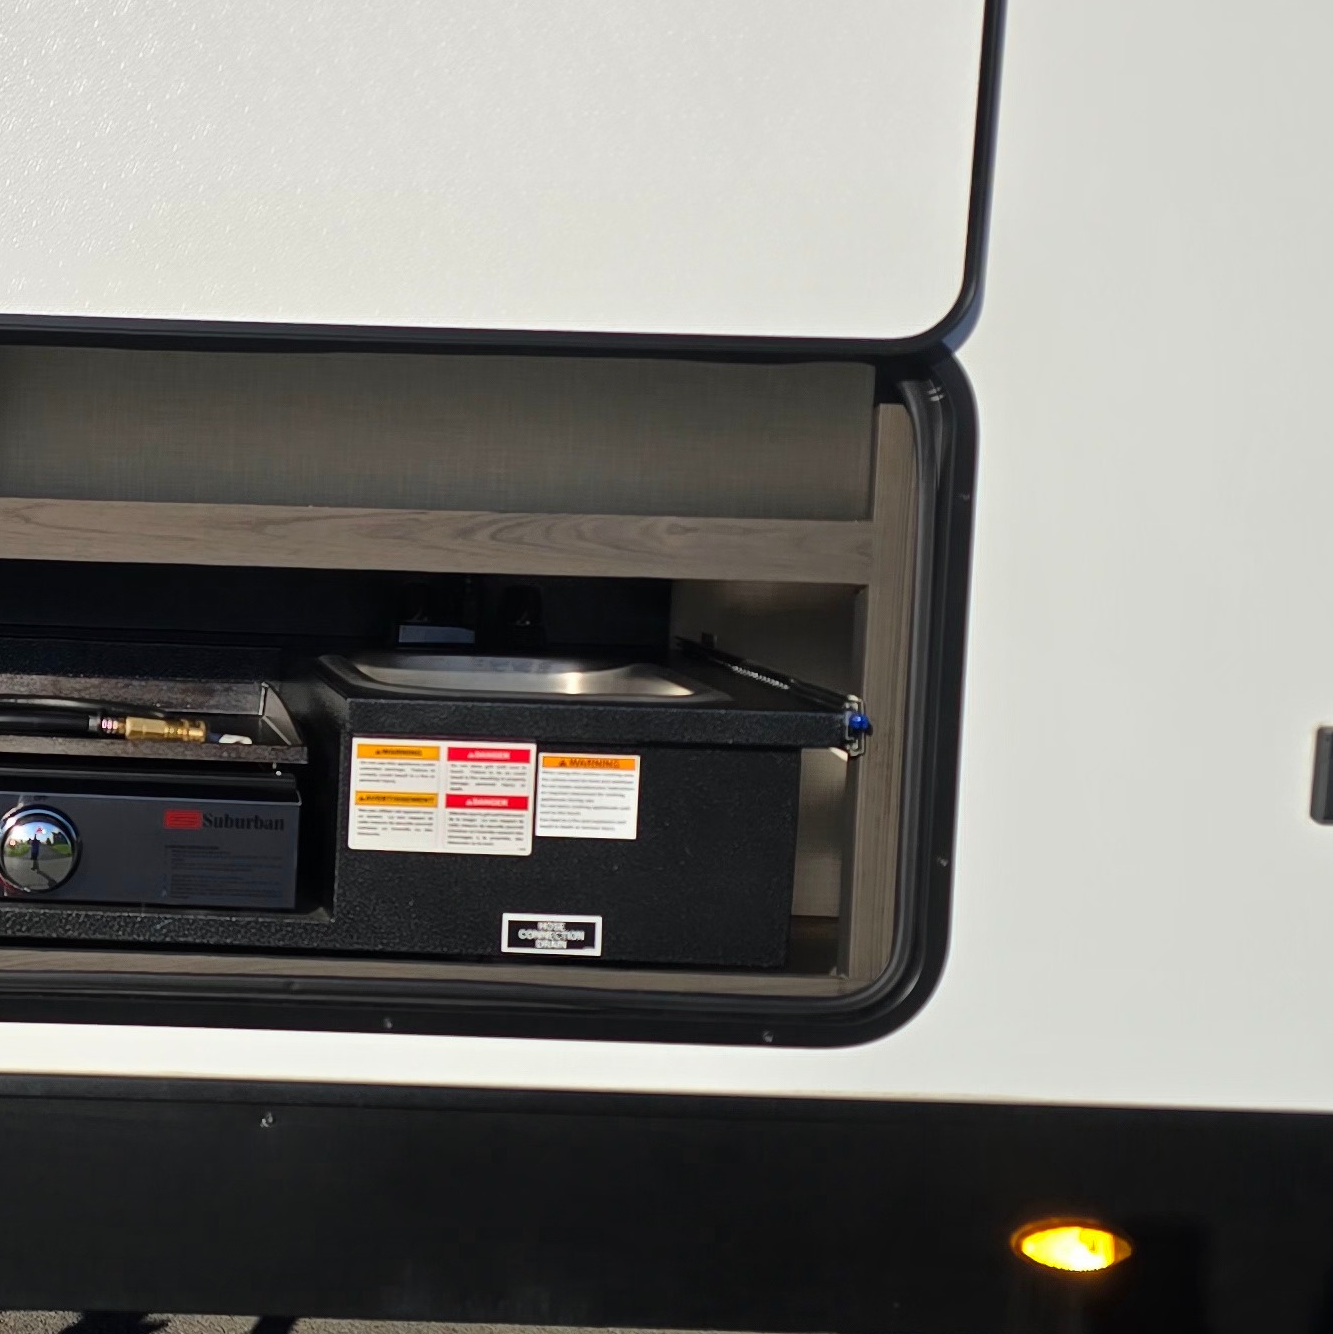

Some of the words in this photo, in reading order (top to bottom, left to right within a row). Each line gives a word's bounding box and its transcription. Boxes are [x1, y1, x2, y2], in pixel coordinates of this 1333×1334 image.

[569, 758, 621, 769] WARNING
[202, 812, 285, 831] Suburban
[518, 929, 585, 940] CONNECTION
